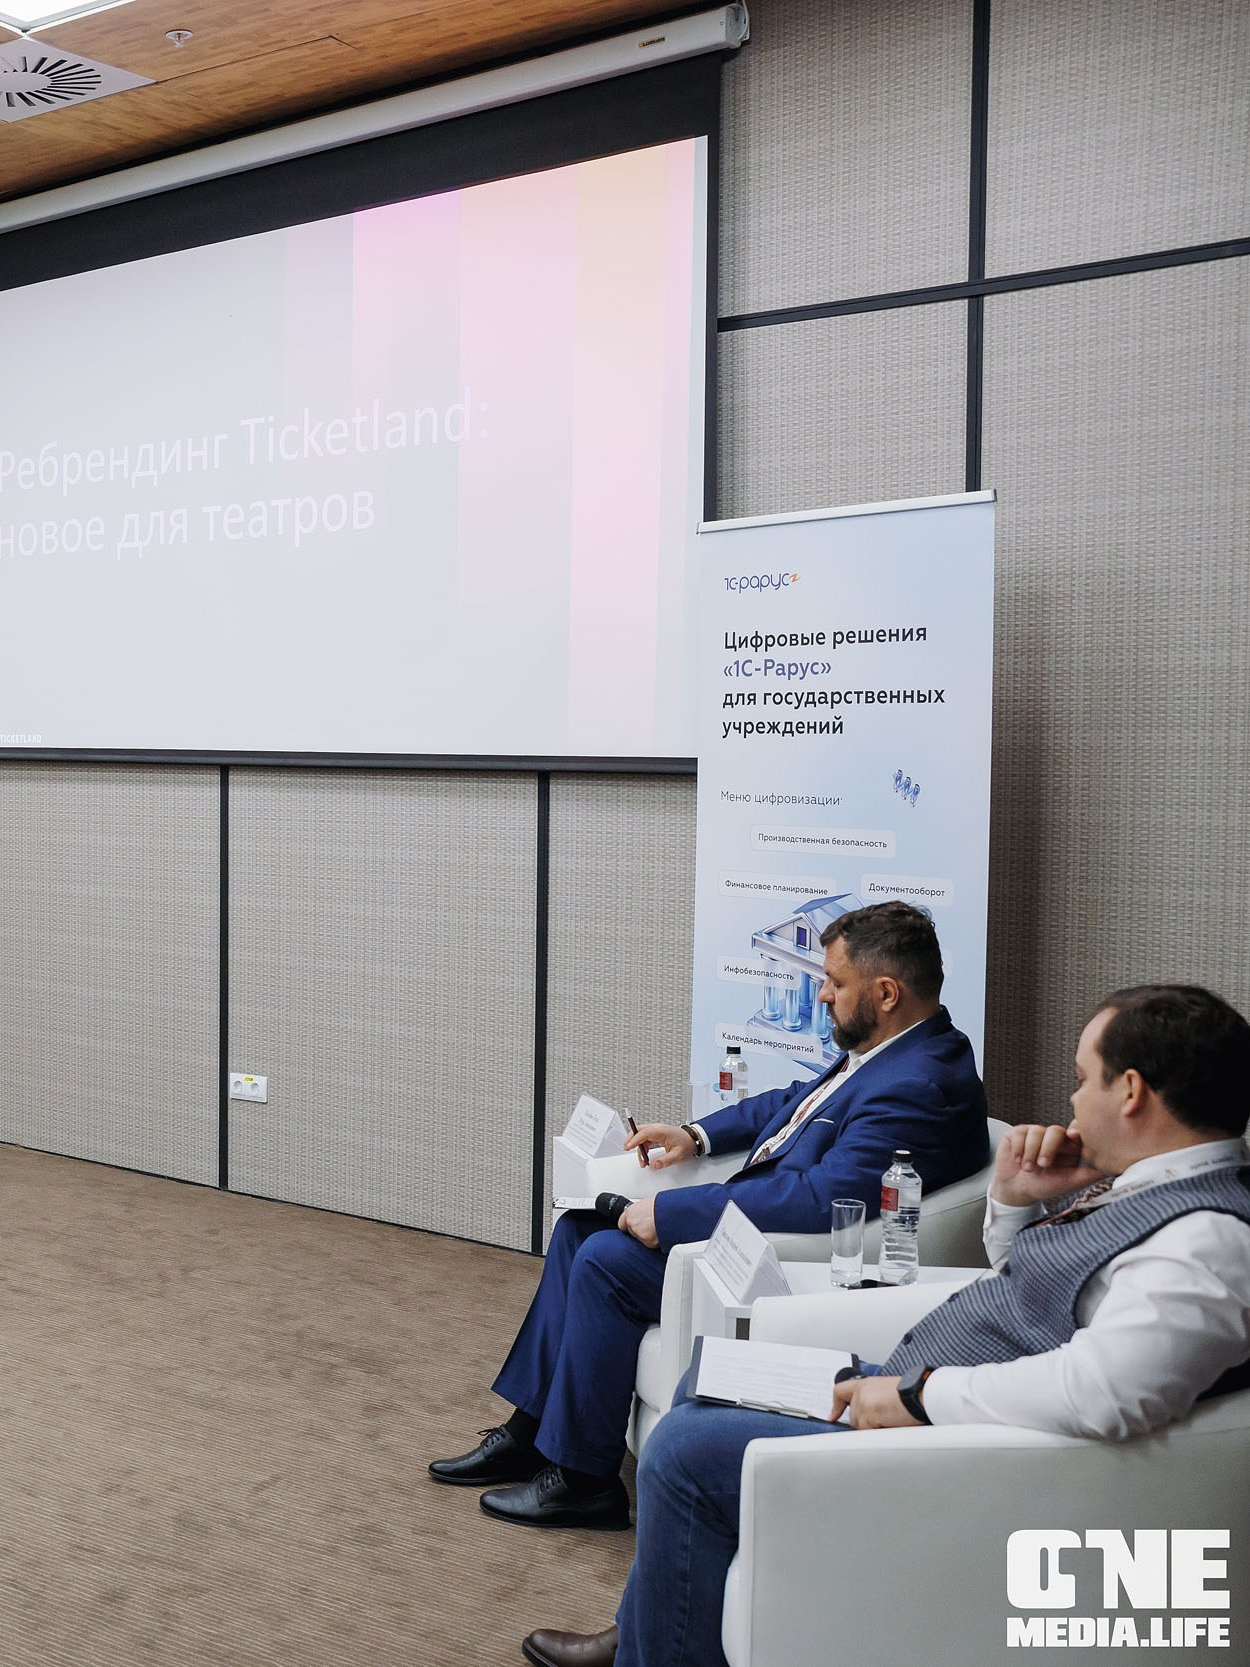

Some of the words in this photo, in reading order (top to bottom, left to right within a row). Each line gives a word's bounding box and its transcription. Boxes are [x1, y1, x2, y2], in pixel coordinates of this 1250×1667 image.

[239, 386, 489, 465] Ticketland:
[117, 507, 189, 560] для
[202, 489, 375, 547] театров
[724, 630, 826, 652] Цифровые
[832, 627, 927, 649] решения
[723, 658, 832, 680] «1С-Рарус»
[722, 692, 757, 709] для
[763, 687, 946, 709] государственных
[722, 715, 844, 739] учреждений
[720, 791, 751, 803] Меню
[758, 833, 830, 845] Производственная
[831, 837, 888, 849] безопасность
[725, 880, 771, 891] Финансовое
[772, 885, 829, 896] планирование
[868, 883, 946, 897] Документооборот
[724, 964, 795, 981] Инфобезопасность
[722, 1032, 763, 1047] Календарь
[763, 1040, 815, 1054] мероприятий
